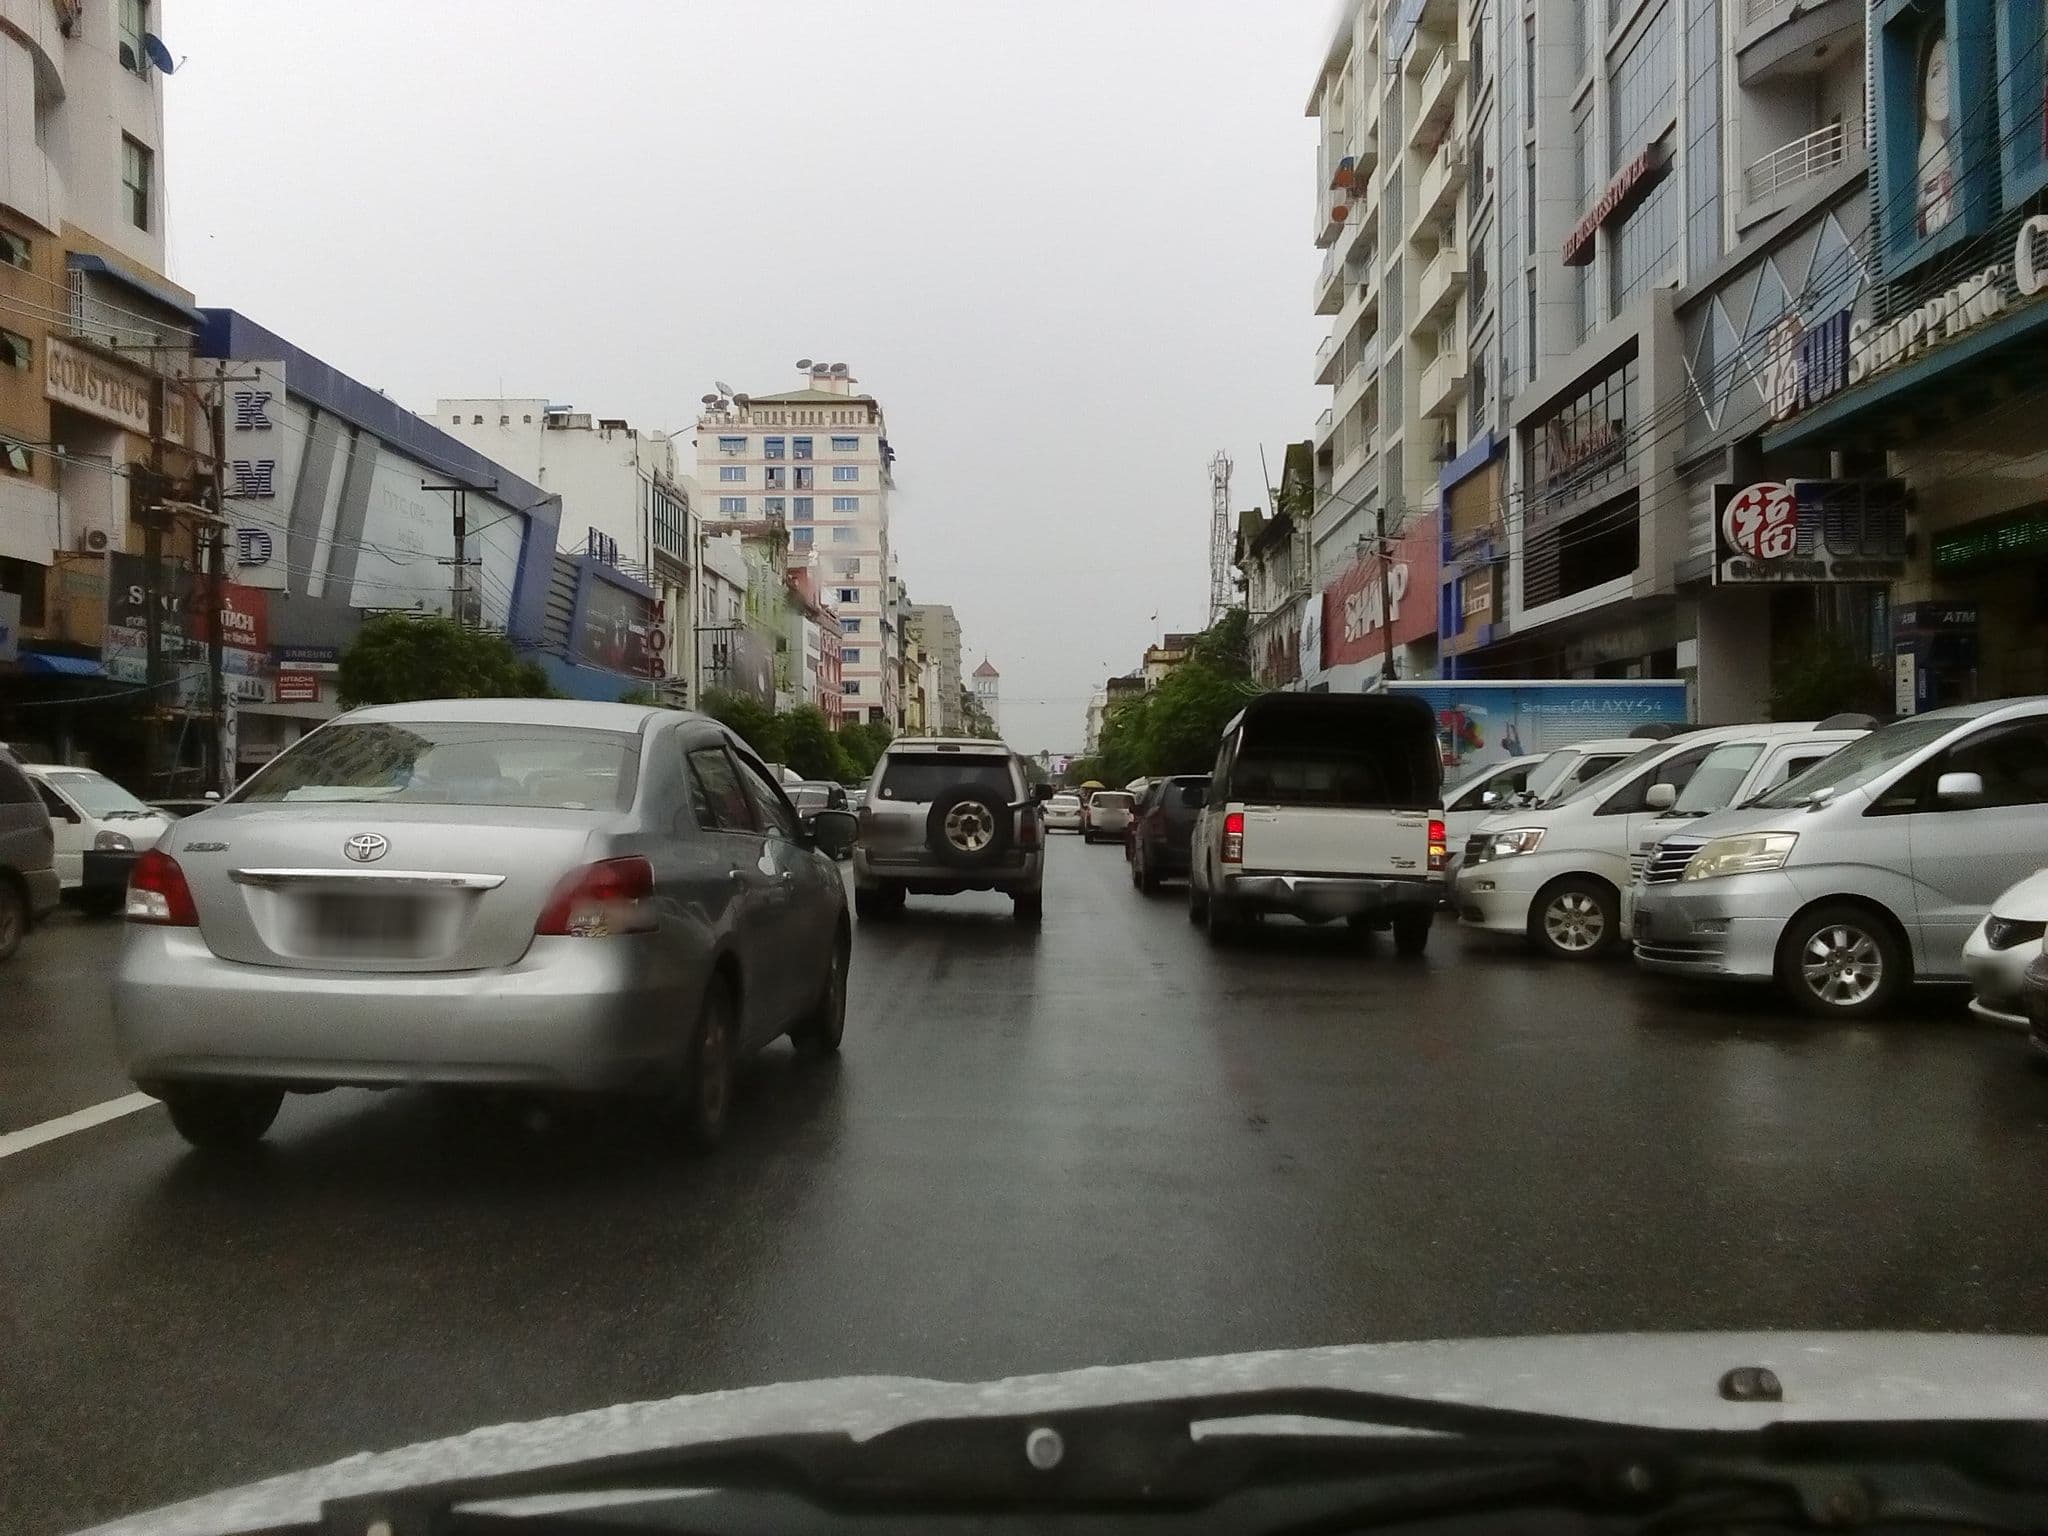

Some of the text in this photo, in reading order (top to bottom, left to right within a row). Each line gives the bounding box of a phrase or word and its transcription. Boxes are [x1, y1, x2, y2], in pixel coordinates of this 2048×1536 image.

[1344, 562, 1409, 642] SHAP
[1942, 611, 1977, 623] ATM
[285, 650, 333, 659] SAMSUNG
[1569, 698, 1634, 714] GALAXY
